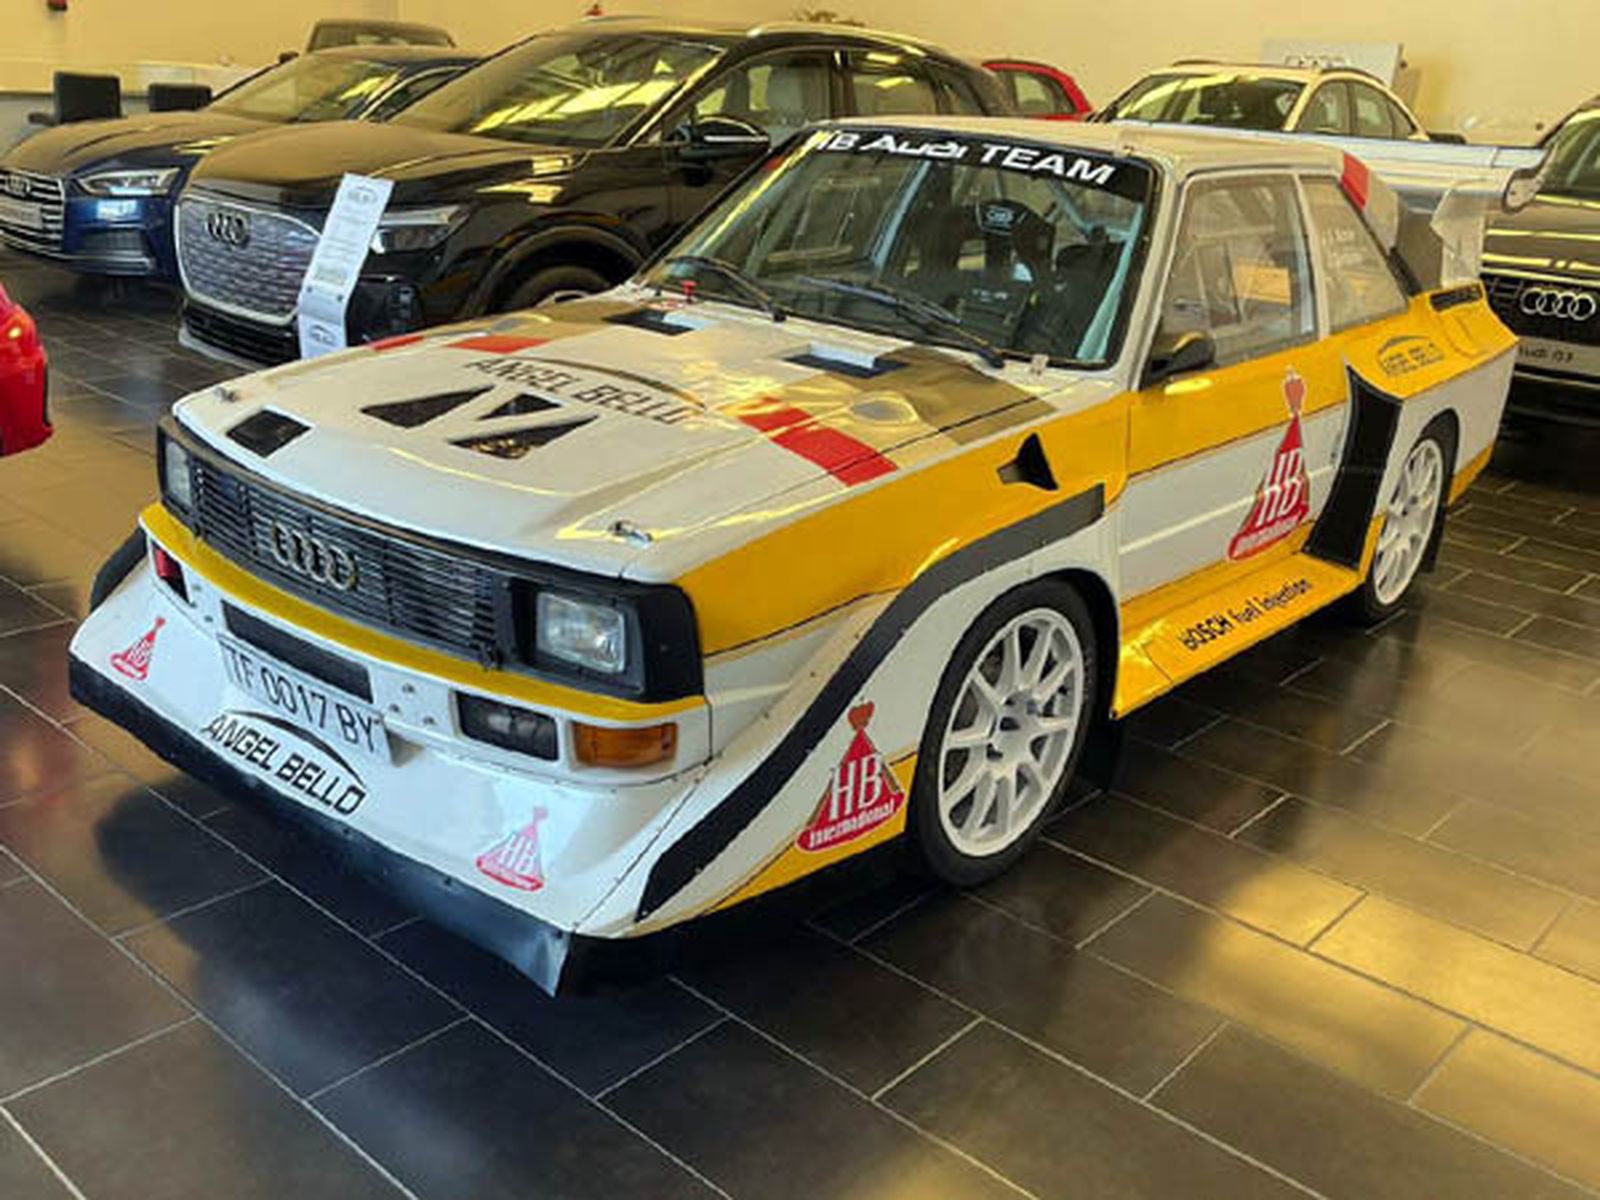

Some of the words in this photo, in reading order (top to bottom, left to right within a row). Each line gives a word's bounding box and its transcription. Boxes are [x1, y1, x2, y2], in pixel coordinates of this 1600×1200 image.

[980, 143, 1117, 186] TEAM
[464, 356, 584, 394] ANGEL
[570, 383, 706, 425] BELLO
[1255, 447, 1303, 528] HB
[219, 640, 255, 690] TF
[260, 666, 326, 730] 0017
[335, 703, 375, 754] BY
[199, 713, 280, 772] ANGEL
[275, 752, 367, 816] BELLO
[829, 751, 883, 822] HB
